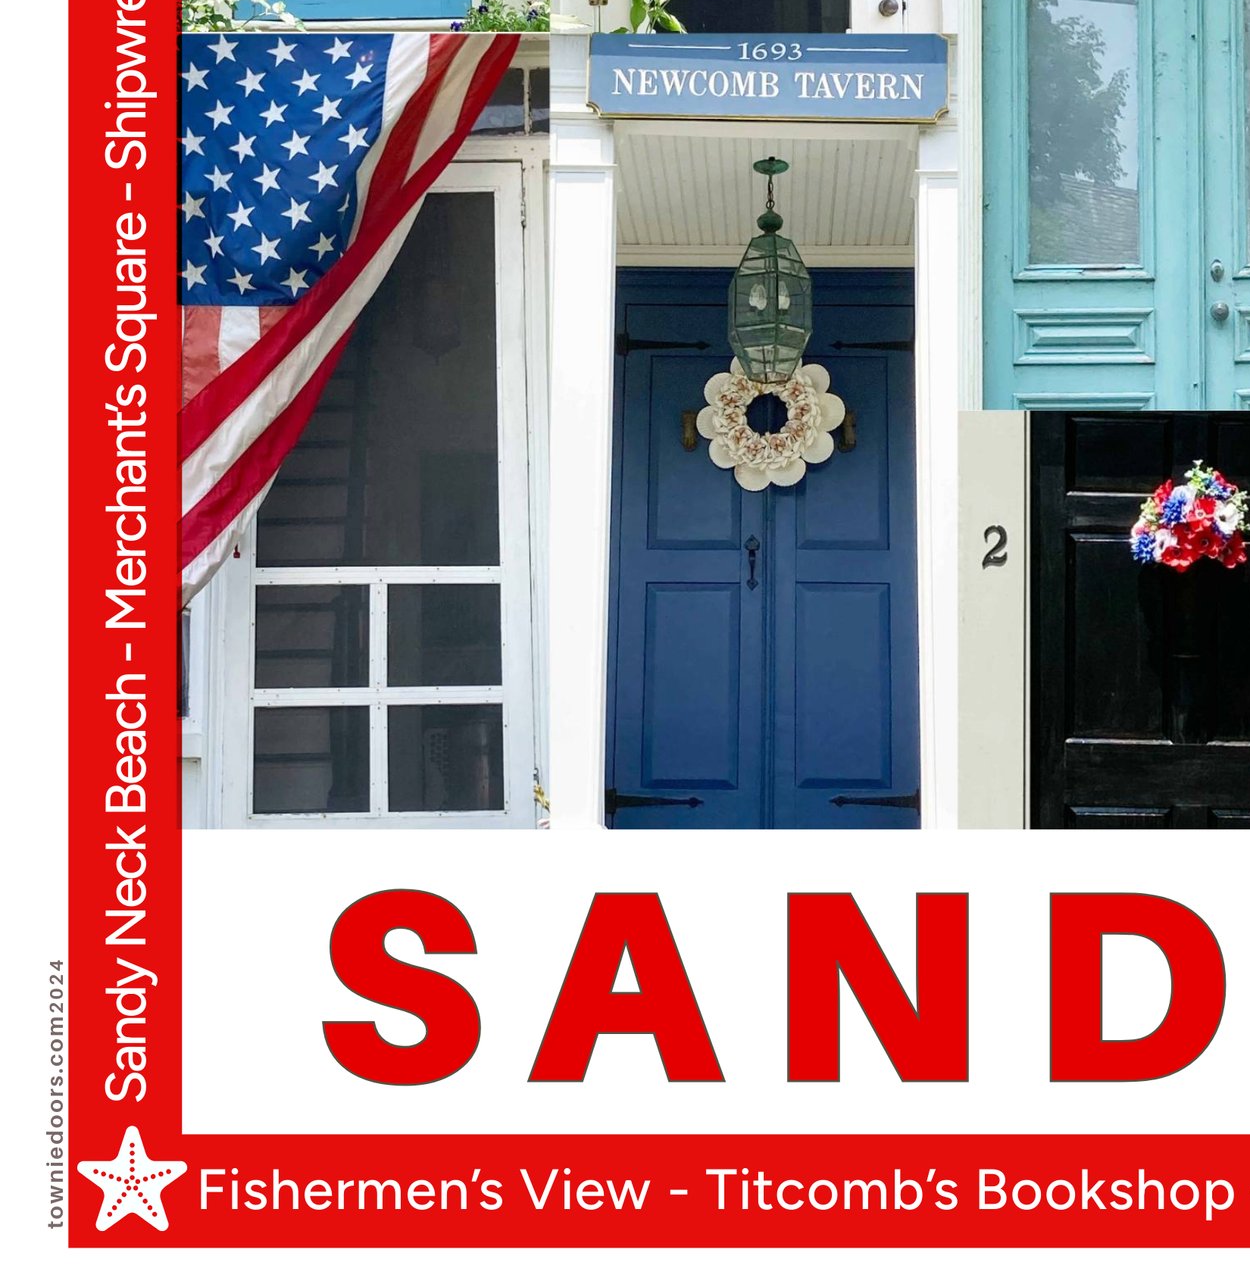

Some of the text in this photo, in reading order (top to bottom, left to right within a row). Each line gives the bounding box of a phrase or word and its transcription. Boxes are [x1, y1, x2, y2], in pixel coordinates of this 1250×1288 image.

[611, 68, 925, 101] NEWCOMB TAVERN
[738, 41, 804, 62] 1693
[104, 212, 158, 373] Square
[104, 384, 147, 629] Merchant’s
[981, 525, 1009, 570] 2
[105, 673, 147, 813] Beach
[105, 824, 147, 945] Neck
[104, 957, 159, 1103] Sandy
[200, 1167, 503, 1211] Fishermen’s
[519, 1167, 651, 1211] View
[705, 1167, 958, 1211] Titcomb’s
[978, 1167, 1235, 1221] Bookshop
